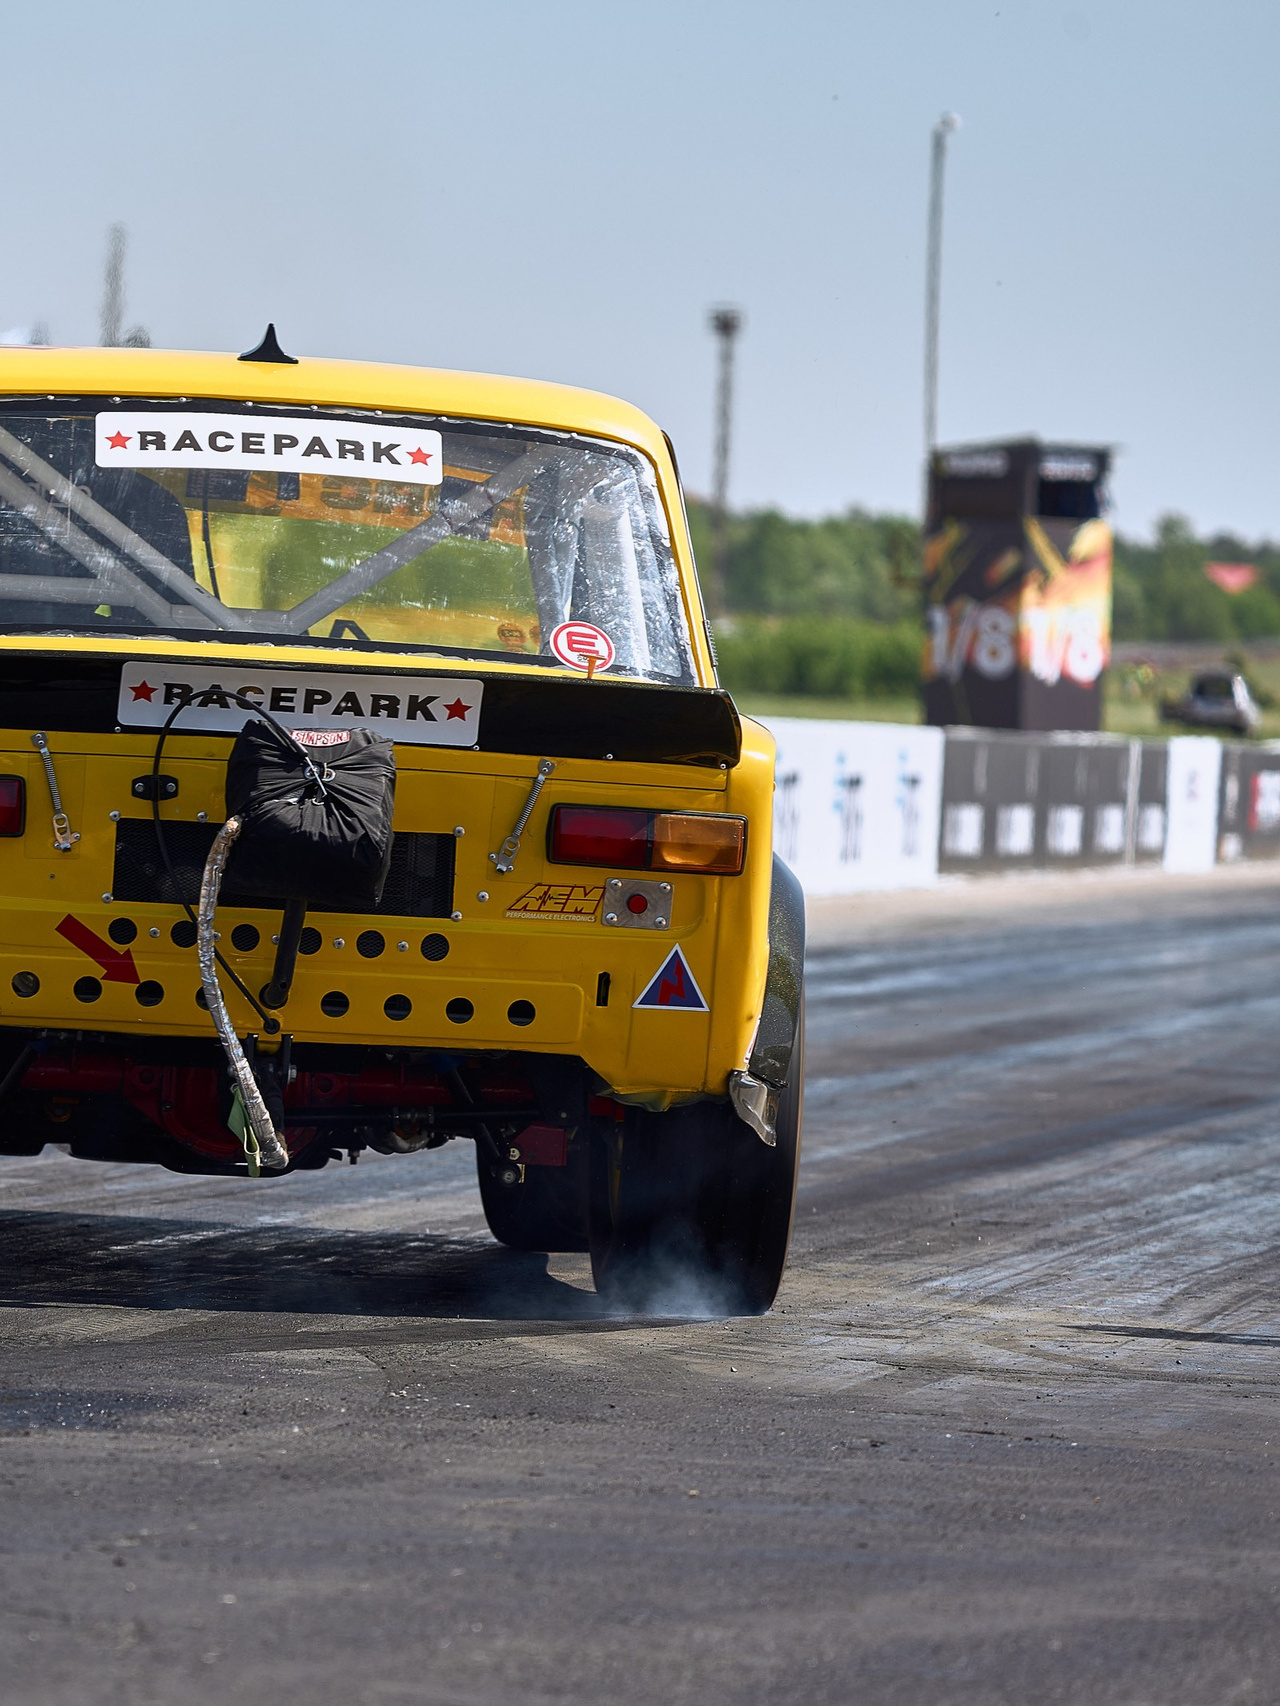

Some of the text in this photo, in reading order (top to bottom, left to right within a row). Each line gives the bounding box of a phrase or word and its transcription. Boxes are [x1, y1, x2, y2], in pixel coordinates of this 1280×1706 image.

[137, 430, 402, 465] RACEPARK
[566, 631, 599, 654] E
[163, 682, 440, 722] RACEPARK
[294, 731, 344, 745] SIMPSON
[507, 884, 607, 914] AEM
[506, 911, 596, 922] PERFORMANCE ELECTRONICS
